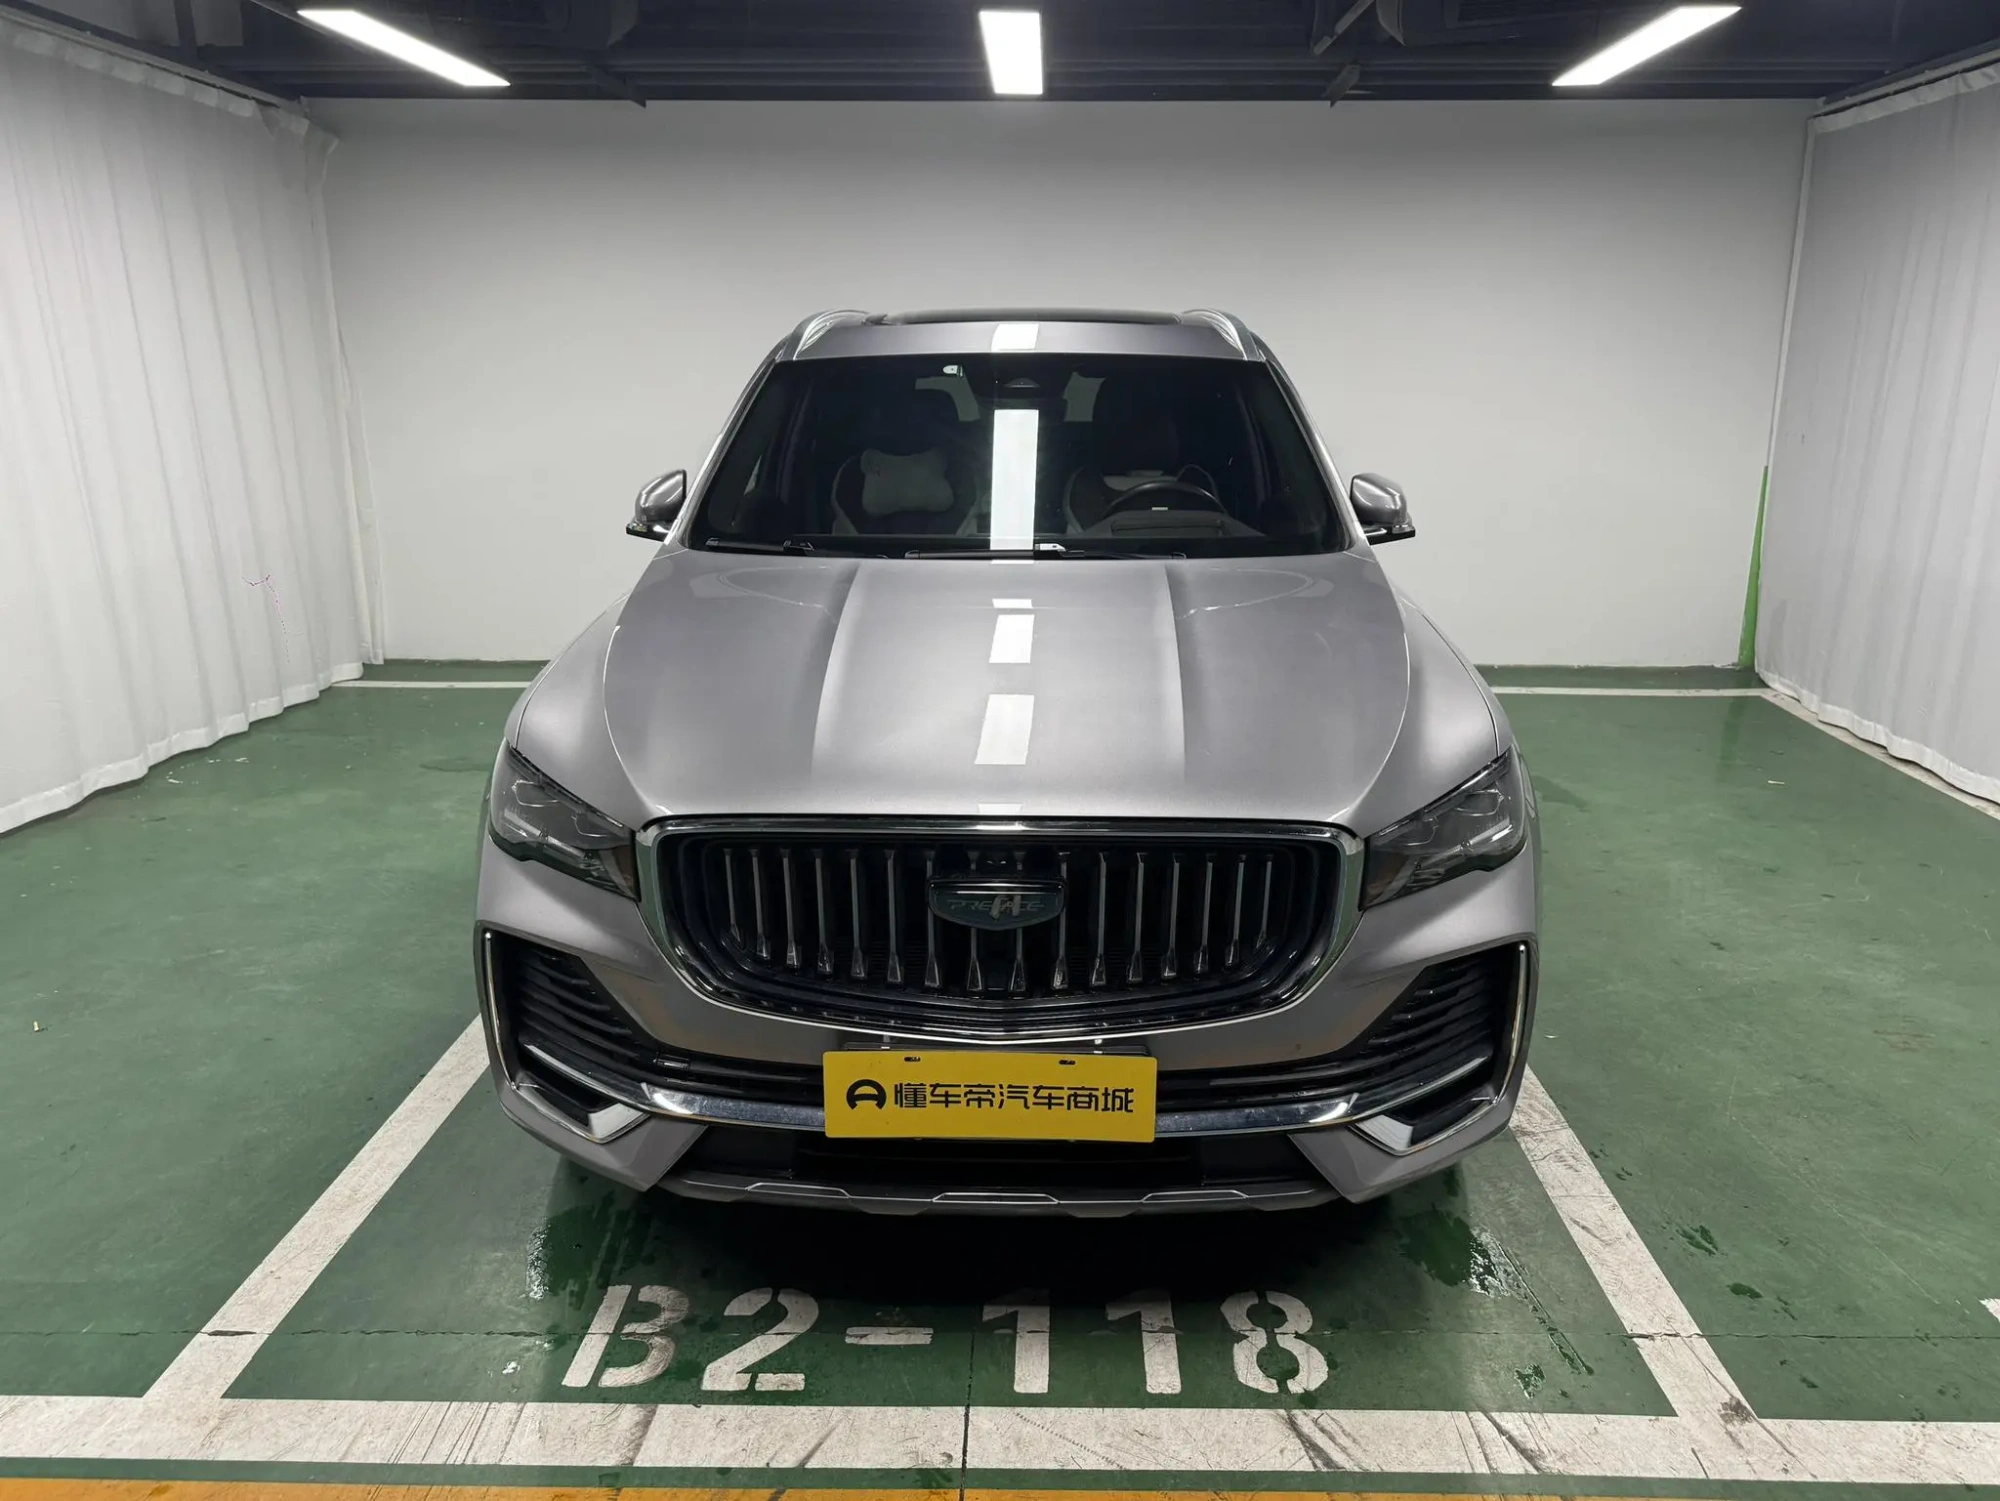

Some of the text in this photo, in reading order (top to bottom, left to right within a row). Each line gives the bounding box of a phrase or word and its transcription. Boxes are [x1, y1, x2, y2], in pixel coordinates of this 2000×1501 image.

[947, 899, 1045, 911] PRECE
[894, 1082, 1135, 1113] 懂车帝汽车商城
[561, 1284, 1328, 1394] B2-118
